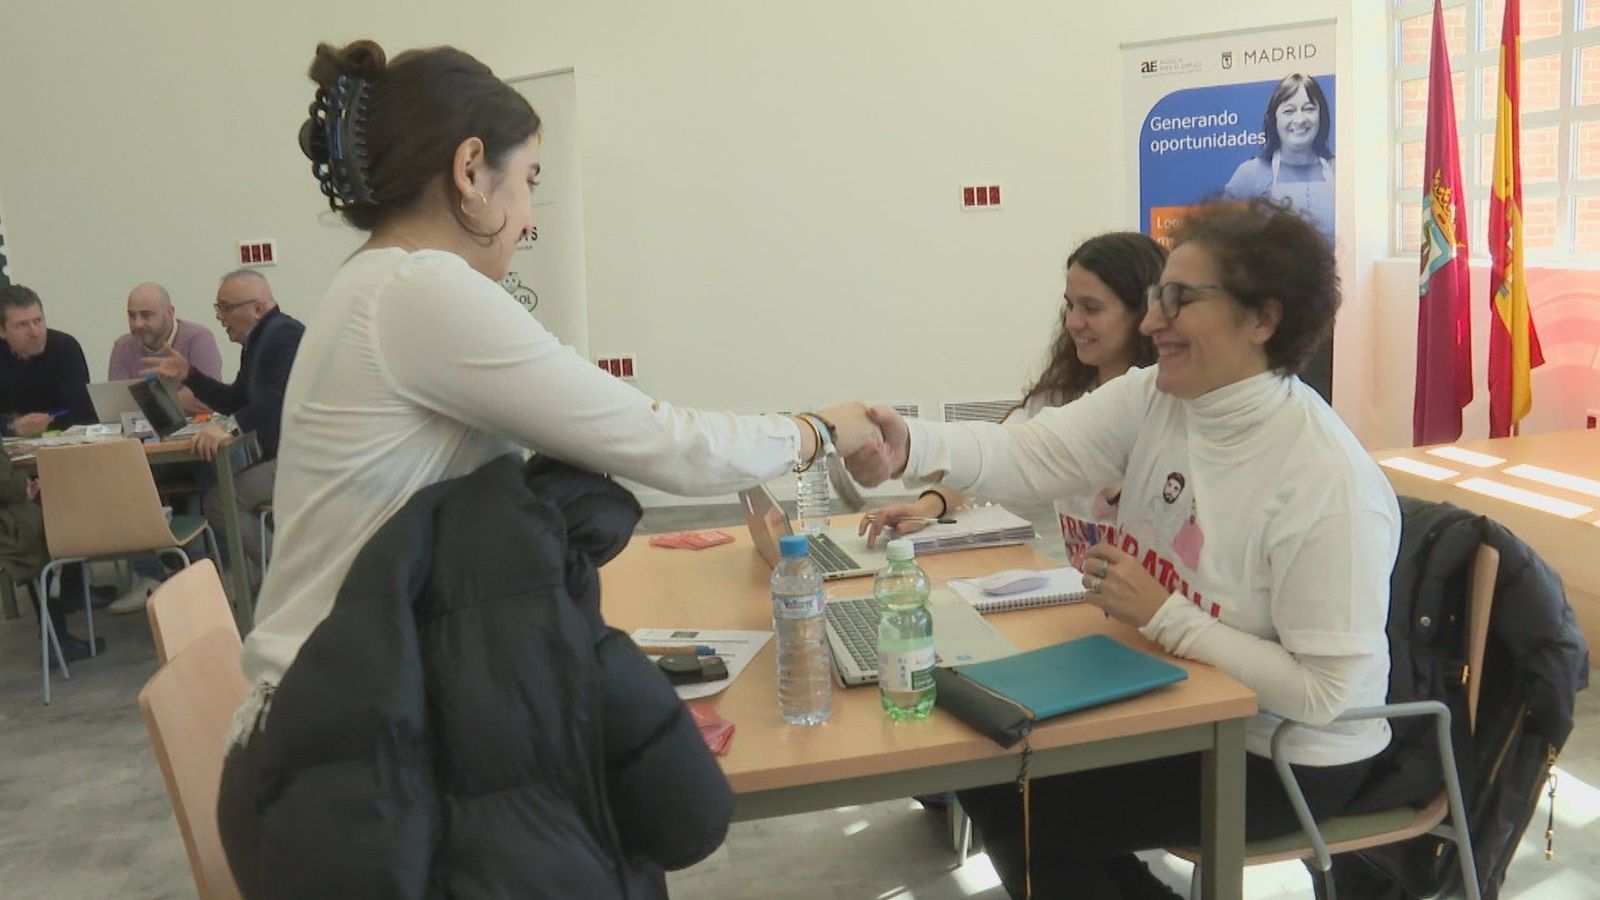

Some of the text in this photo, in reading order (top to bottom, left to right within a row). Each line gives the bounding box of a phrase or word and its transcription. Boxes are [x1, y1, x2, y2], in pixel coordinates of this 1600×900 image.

[1244, 43, 1317, 66] MADRID
[1150, 110, 1238, 131] Generando
[1150, 130, 1266, 155] oportunidades
